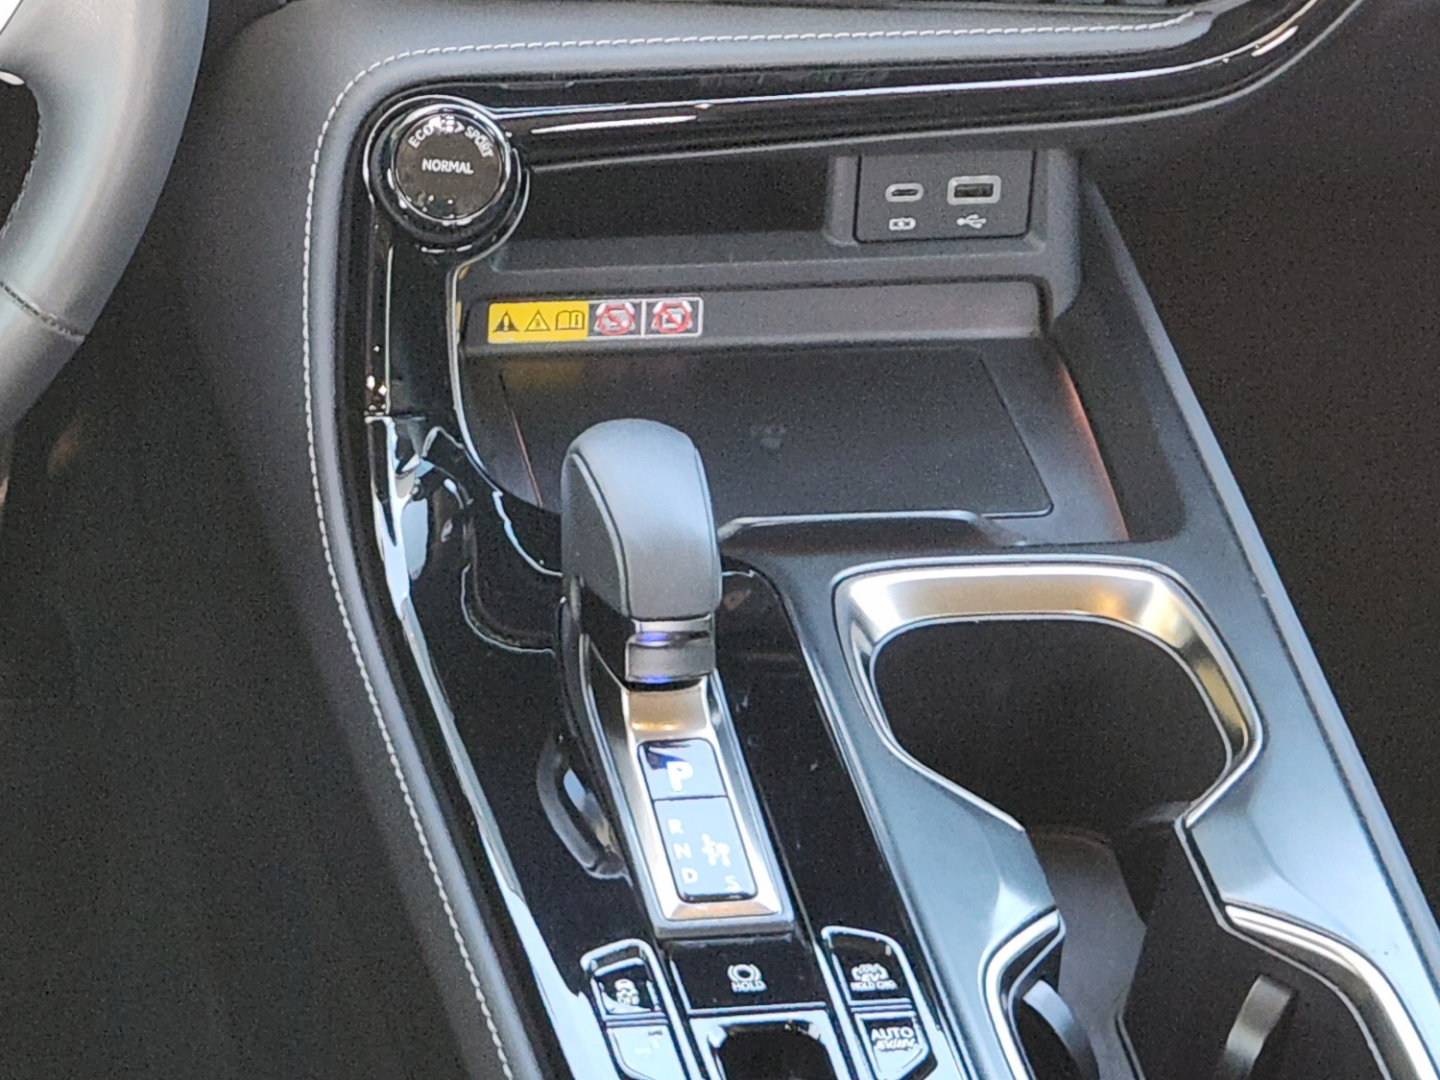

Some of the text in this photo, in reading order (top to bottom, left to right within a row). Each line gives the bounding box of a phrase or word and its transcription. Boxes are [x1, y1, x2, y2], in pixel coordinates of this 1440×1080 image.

[408, 126, 434, 149] ECO
[464, 125, 495, 159] SPORT
[421, 158, 474, 175] NORMAL
[666, 760, 694, 792] P
[681, 866, 698, 885] D
[732, 979, 768, 993] HOLD
[871, 1026, 914, 1041] AUTO
